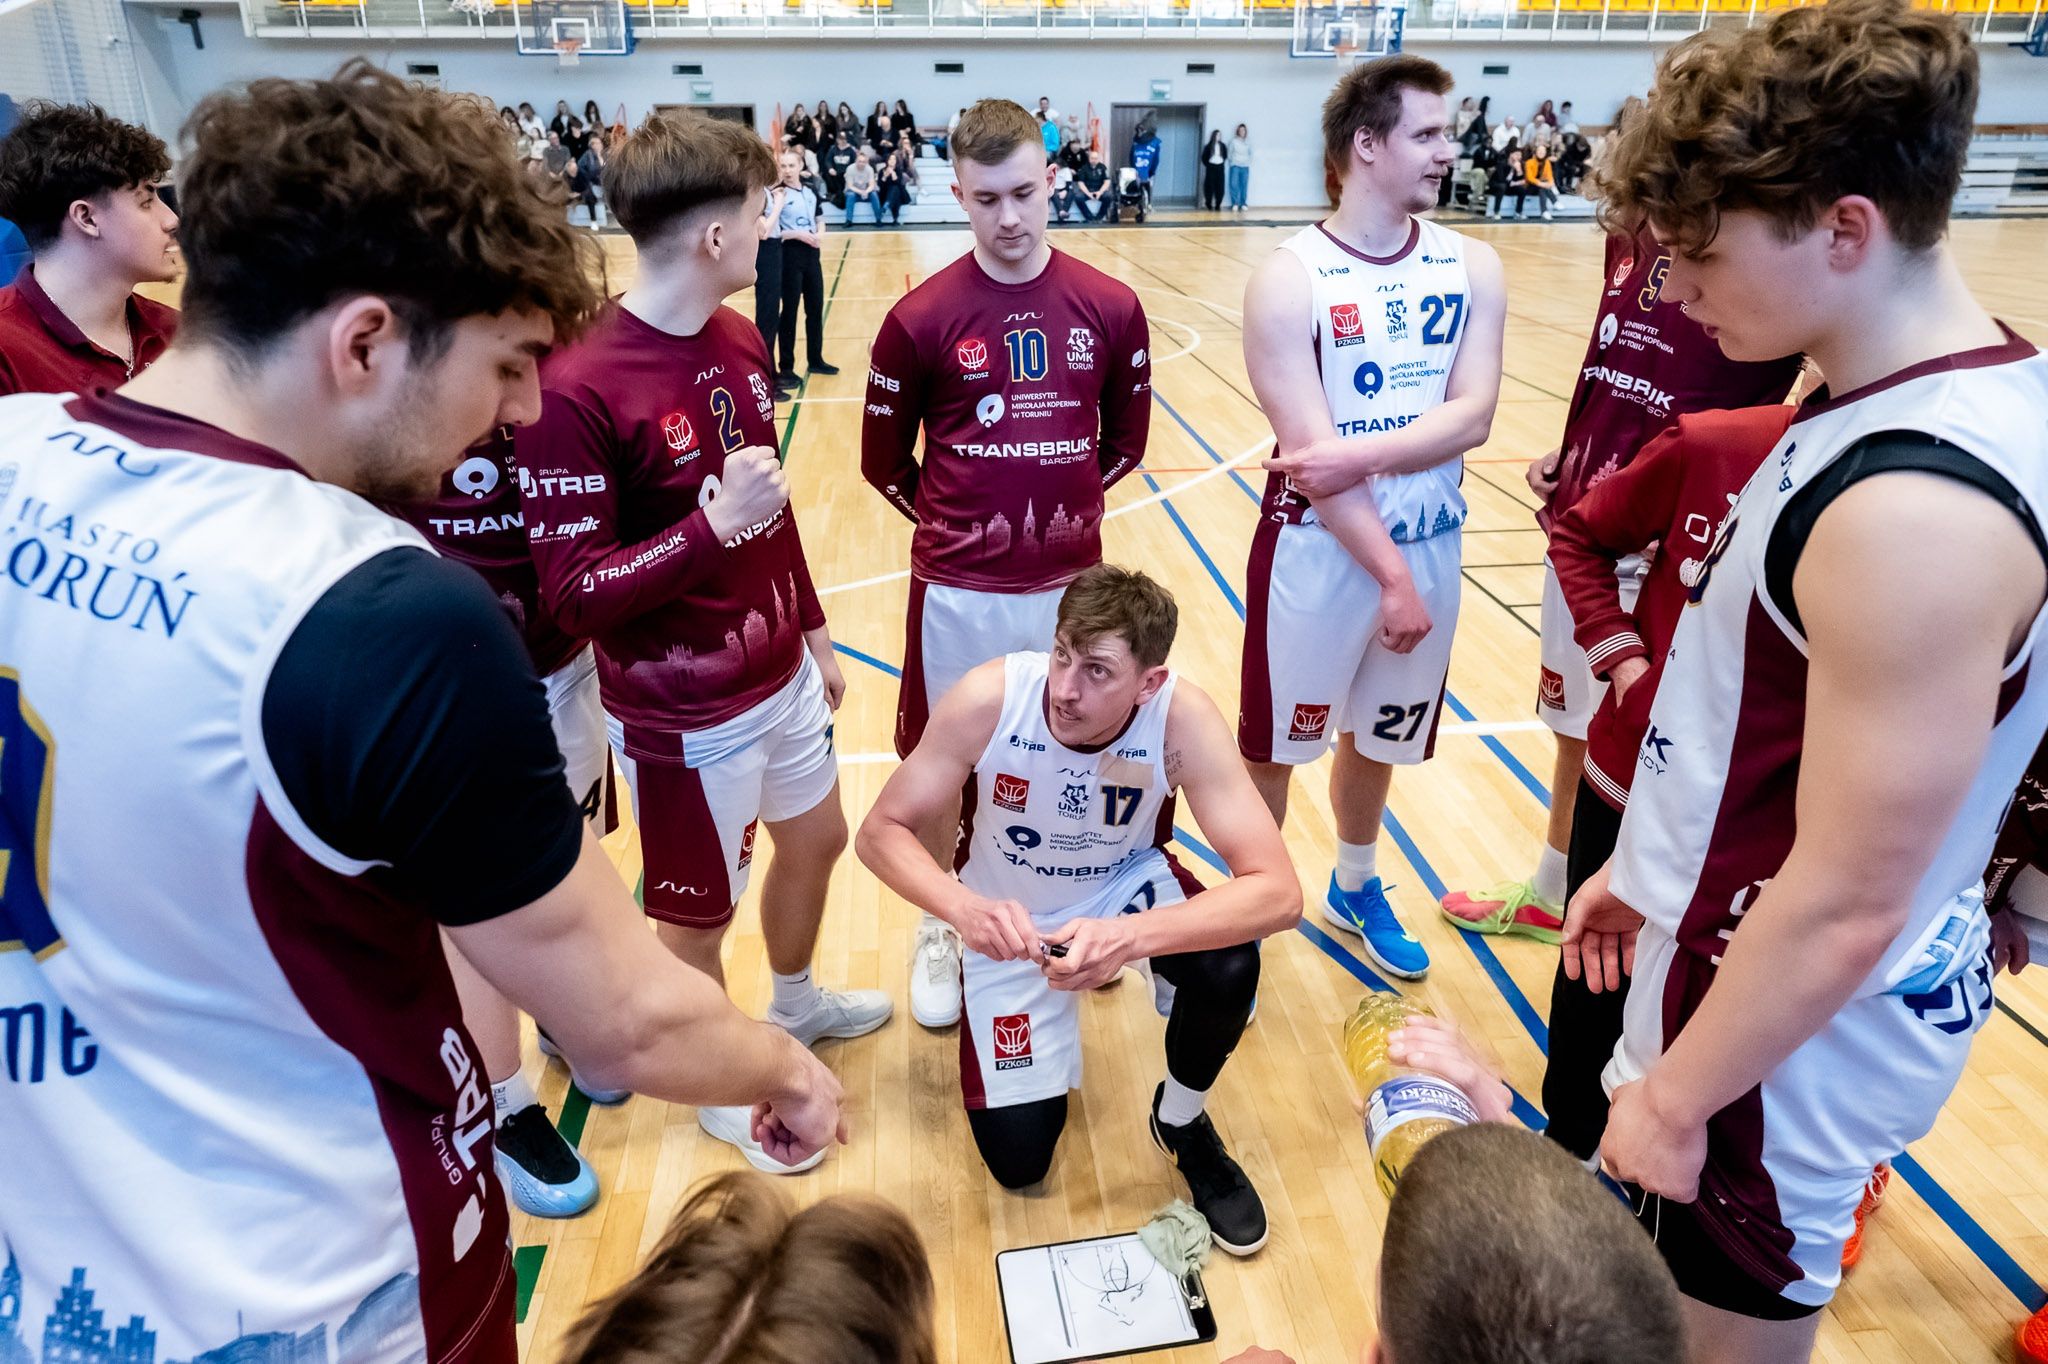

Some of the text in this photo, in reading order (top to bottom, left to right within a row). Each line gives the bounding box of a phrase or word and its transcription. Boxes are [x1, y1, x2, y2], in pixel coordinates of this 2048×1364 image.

[1420, 293, 1464, 346] 27
[1003, 328, 1049, 382] 10
[1066, 351, 1094, 364] UMK
[1011, 391, 1058, 401] UNIWERSYTET
[1020, 411, 1052, 419] TORUNIU
[710, 386, 745, 455] 2
[952, 437, 1091, 458] TRANSBRUK
[539, 474, 607, 497] TRB
[0, 526, 200, 638] ORUŃ
[1372, 700, 1430, 742] 27
[1101, 784, 1144, 826] 17
[440, 1027, 492, 1172] TRB
[431, 1112, 463, 1186] GRUPA
